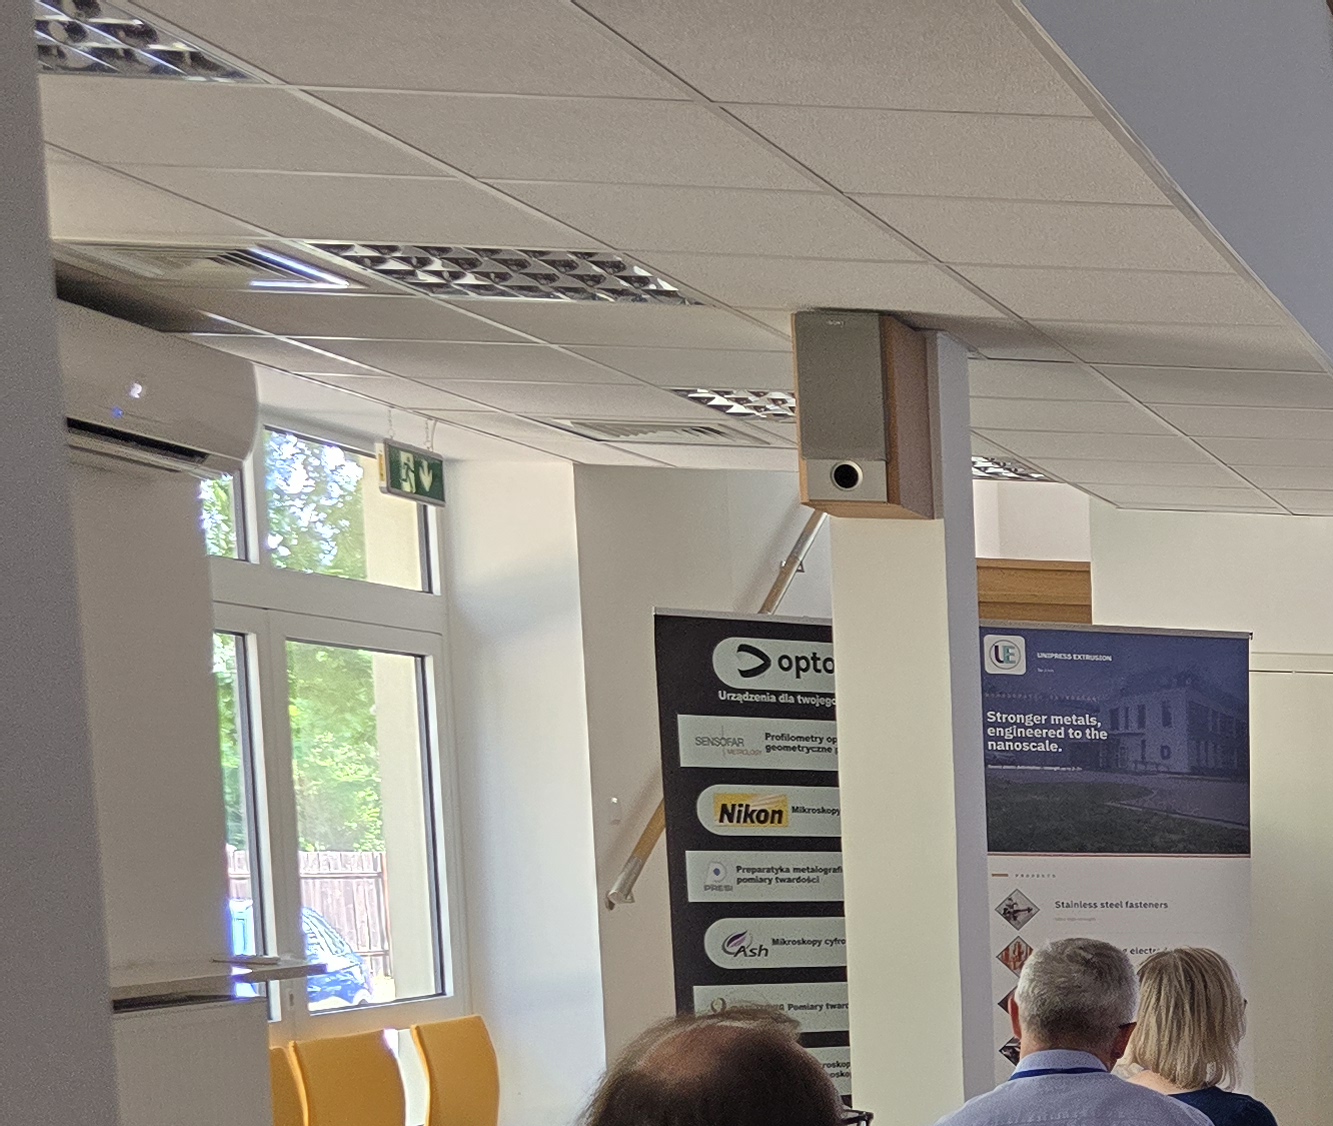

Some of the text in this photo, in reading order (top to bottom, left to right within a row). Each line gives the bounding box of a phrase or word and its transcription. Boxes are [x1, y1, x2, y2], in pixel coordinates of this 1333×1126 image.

[718, 690, 777, 703] Urządzenia
[778, 693, 795, 703] dla
[987, 711, 1101, 728] Stronger metals,
[765, 732, 824, 744] Profilometry
[987, 726, 1108, 740] engineered to the
[695, 737, 745, 748] SENSOFAR
[987, 740, 1063, 752] nanoscale.
[765, 745, 832, 754] geometryczne
[718, 803, 784, 825] Nikon
[791, 806, 840, 817] Mikroskopy
[736, 865, 790, 875] Preparatyka
[736, 876, 819, 885] pomiary twardości
[1055, 900, 1168, 909] Stainless steel fasteners
[771, 938, 822, 947] Mikroskopy
[733, 944, 769, 957] Ash
[787, 1003, 824, 1012] Pomiary
